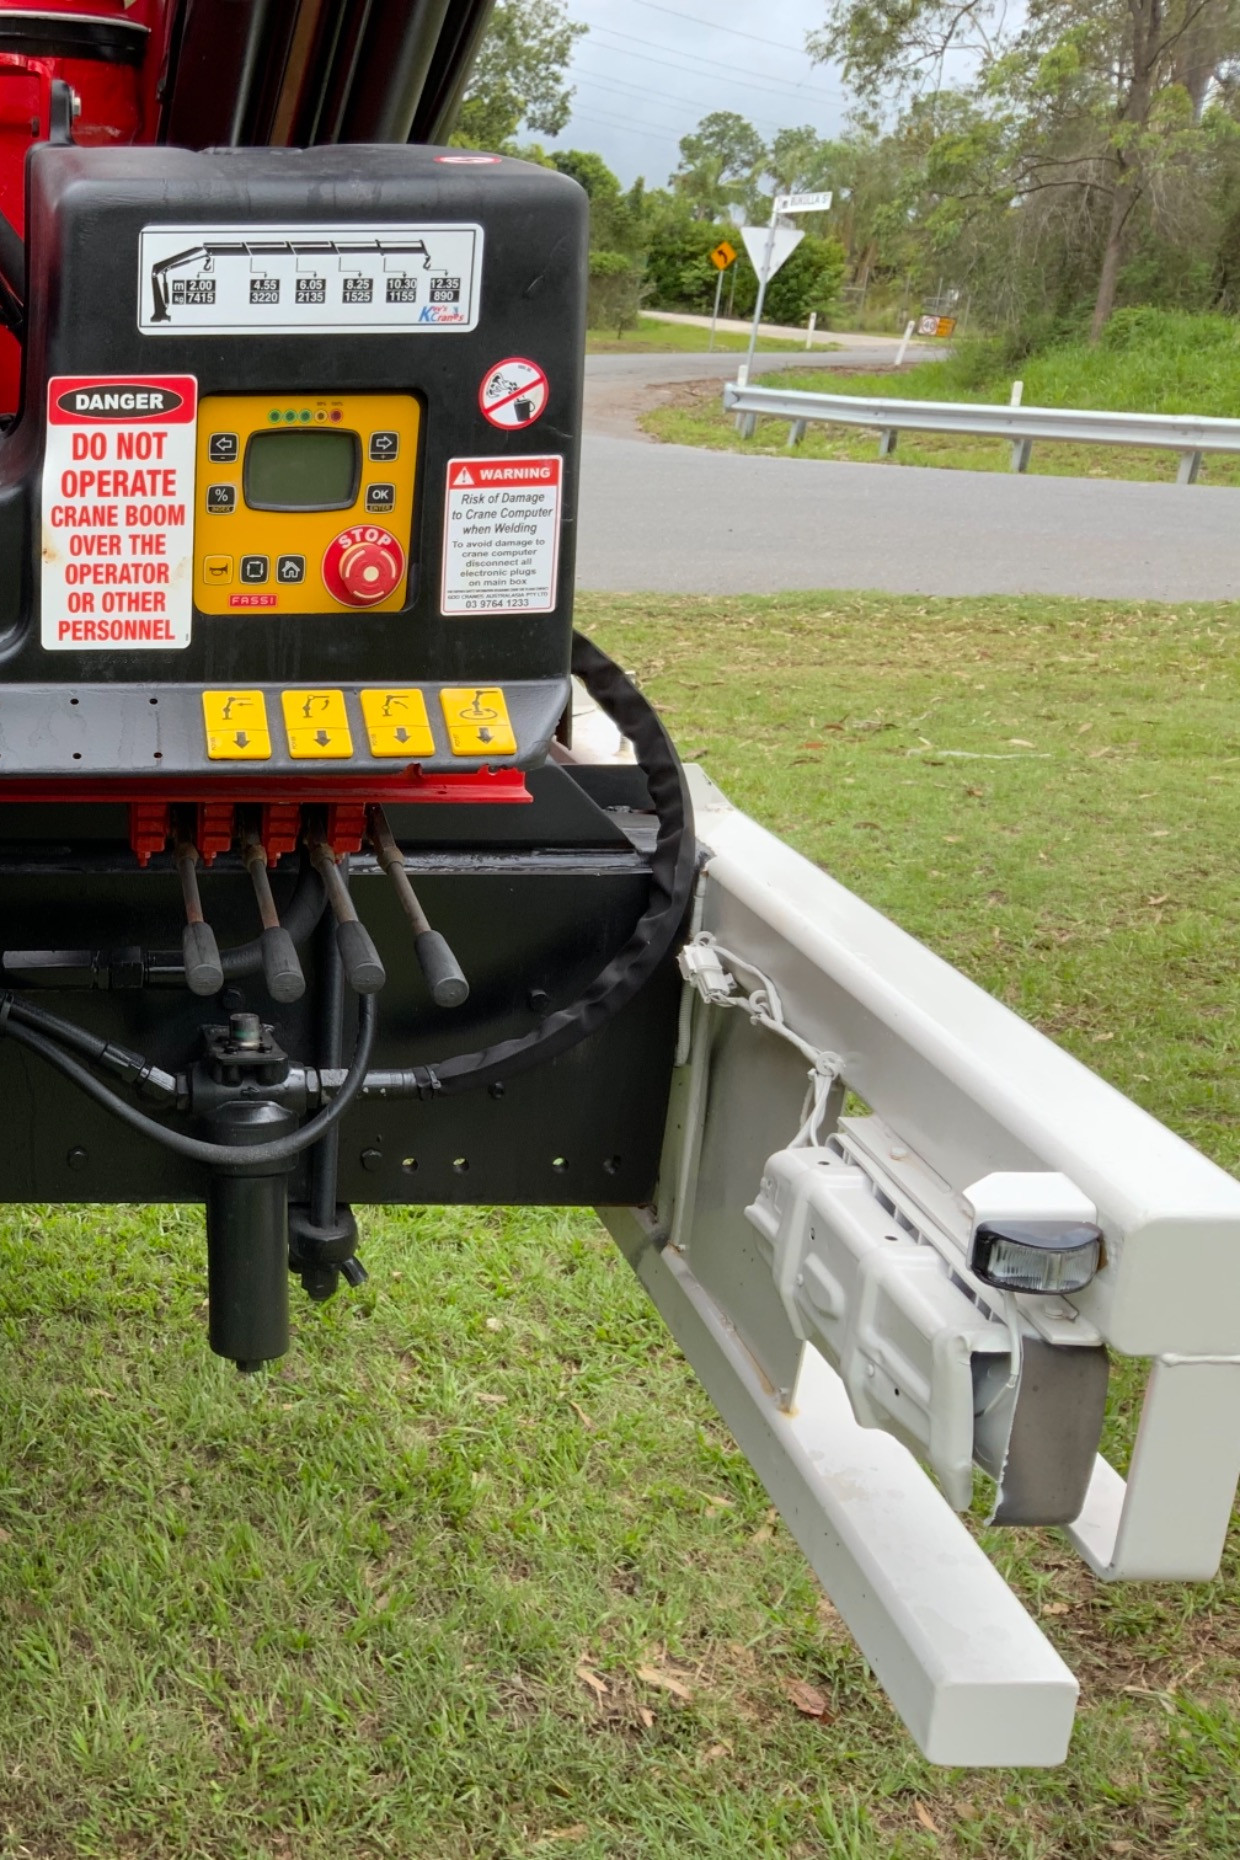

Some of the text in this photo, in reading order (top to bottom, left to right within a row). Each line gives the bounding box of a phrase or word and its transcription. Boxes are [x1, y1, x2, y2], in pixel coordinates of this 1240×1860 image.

[189, 280, 213, 290] 2.00
[253, 280, 277, 289] 4.55
[299, 280, 323, 289] 6.05
[346, 279, 370, 290] 8.25
[388, 279, 417, 290] 10.30
[431, 279, 459, 289] 12.35
[188, 292, 214, 303] 7415
[252, 292, 277, 302] 3220
[298, 292, 323, 302] 2135
[345, 292, 371, 302] 1525
[389, 292, 415, 301] 1155
[433, 291, 454, 301] 890
[75, 394, 164, 410] DANGER
[72, 431, 168, 461] DO NOT
[479, 467, 551, 480] WARNING
[61, 469, 177, 498] OPERATE
[372, 490, 389, 500] OK
[460, 492, 545, 505] Risk of Damage
[51, 504, 185, 528] CRANE BOOM
[452, 506, 553, 520] to Crane Computer
[463, 523, 538, 535] when Welding
[69, 534, 166, 556] OVER THE
[337, 529, 392, 549] STOP
[453, 540, 463, 548] To
[466, 539, 493, 548] avoid
[496, 539, 533, 548] damage
[491, 549, 537, 558] computer
[465, 558, 532, 568] disconnect all
[64, 564, 170, 585] OPERATOR
[460, 568, 536, 577] electronic plugs
[509, 578, 527, 586] box
[67, 592, 166, 613] OR OTHER
[231, 596, 274, 606] FASSI
[465, 598, 529, 608] 03 9764 1233
[58, 620, 176, 641] PERSONNEL
